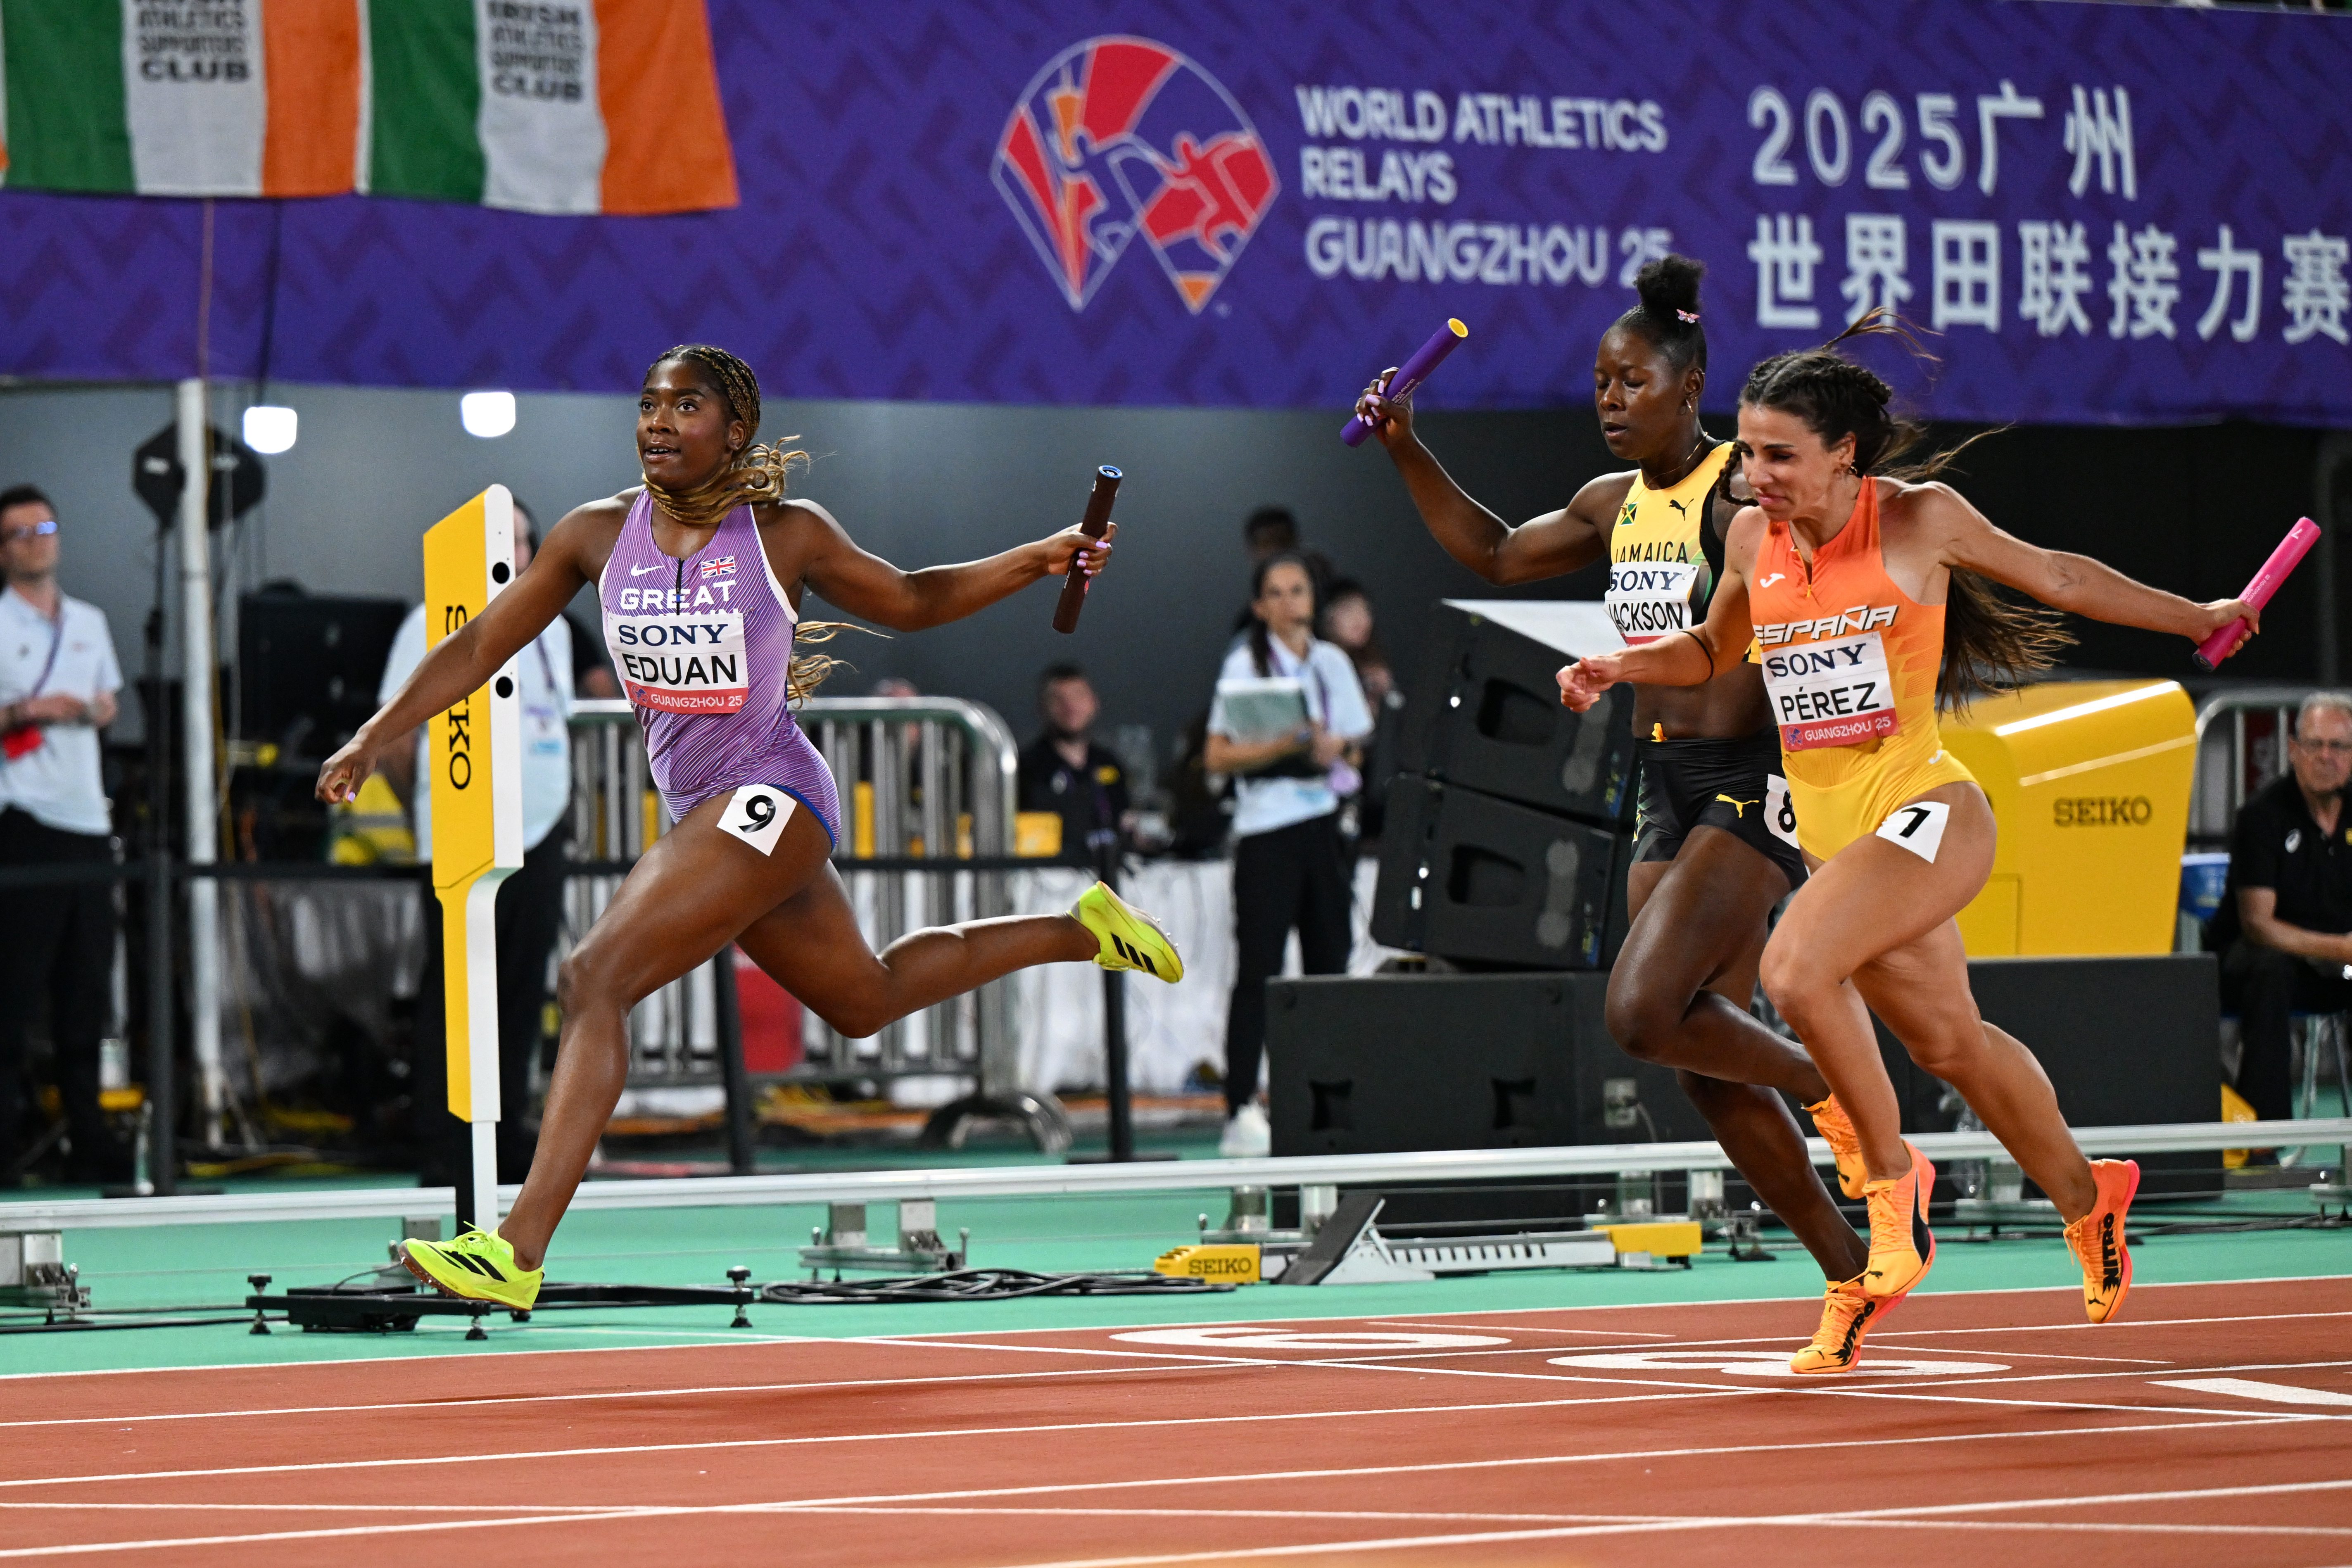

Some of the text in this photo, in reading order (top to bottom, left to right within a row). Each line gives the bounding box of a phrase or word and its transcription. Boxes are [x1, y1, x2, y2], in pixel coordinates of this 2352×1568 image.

[139, 10, 245, 28] ATHLETICS
[487, 1, 580, 25] IRISH
[140, 60, 250, 82] CLUB
[492, 74, 582, 102] CLUB
[1295, 84, 1668, 152] WORLD ATHLETICS
[1749, 80, 2137, 201] 2025广州
[1300, 146, 1457, 204] RELAYS
[1306, 217, 1608, 287] GUANGZHOU
[1747, 214, 2350, 346] 世界田联接力赛
[1615, 541, 1688, 563] JAMAICA
[620, 580, 736, 610] GREAT
[1610, 570, 1682, 592] SONY
[1608, 601, 1684, 632] JACKSON
[1753, 605, 1899, 646] ESPAÑA
[618, 623, 728, 647] SONY
[622, 653, 737, 686] EDUAN
[1766, 643, 1866, 678] SONY
[445, 604, 471, 790] SKO
[651, 694, 743, 708] GUANGZHOU 25
[1780, 681, 1880, 722] PÉREZ
[1805, 716, 1891, 741] GUANGZHOU 25
[738, 794, 777, 834] 9
[1899, 807, 1931, 839] 7
[2053, 795, 2152, 828] SEIKO
[1188, 1257, 1252, 1275] SEIKO
[2102, 1212, 2120, 1296] NITRO
[1829, 1301, 1876, 1363] NITRO
